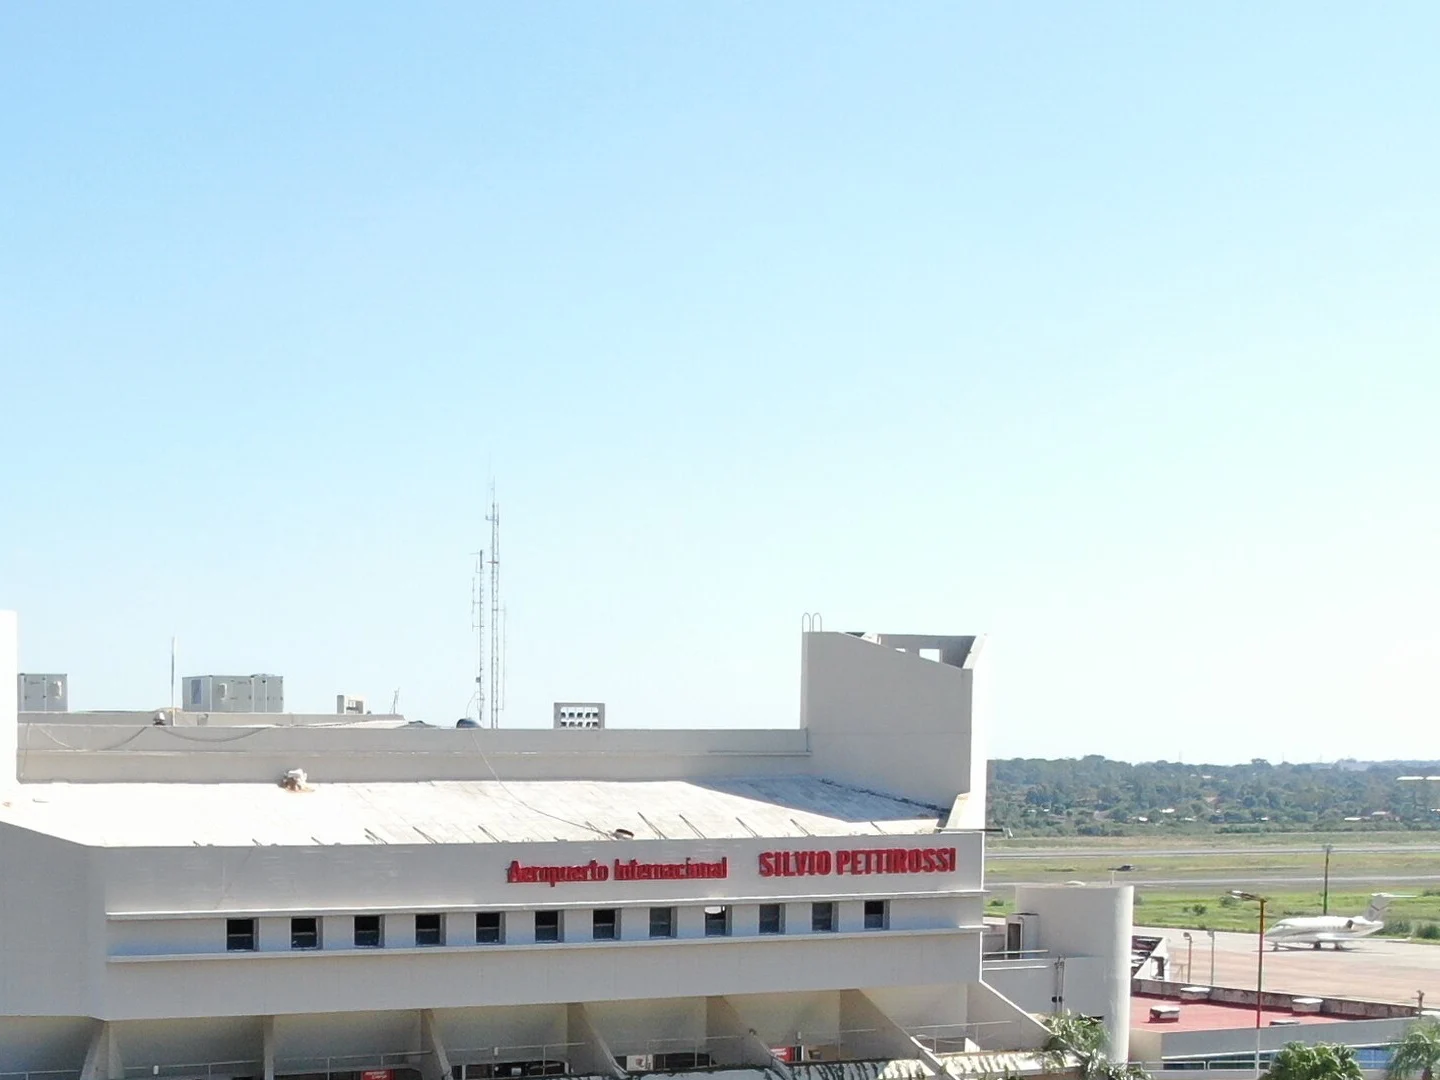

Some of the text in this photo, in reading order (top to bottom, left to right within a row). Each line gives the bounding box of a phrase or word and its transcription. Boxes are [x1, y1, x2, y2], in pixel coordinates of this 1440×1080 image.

[507, 848, 956, 887] Aeropuerto Internacional SILVIO PETTIROSSI
